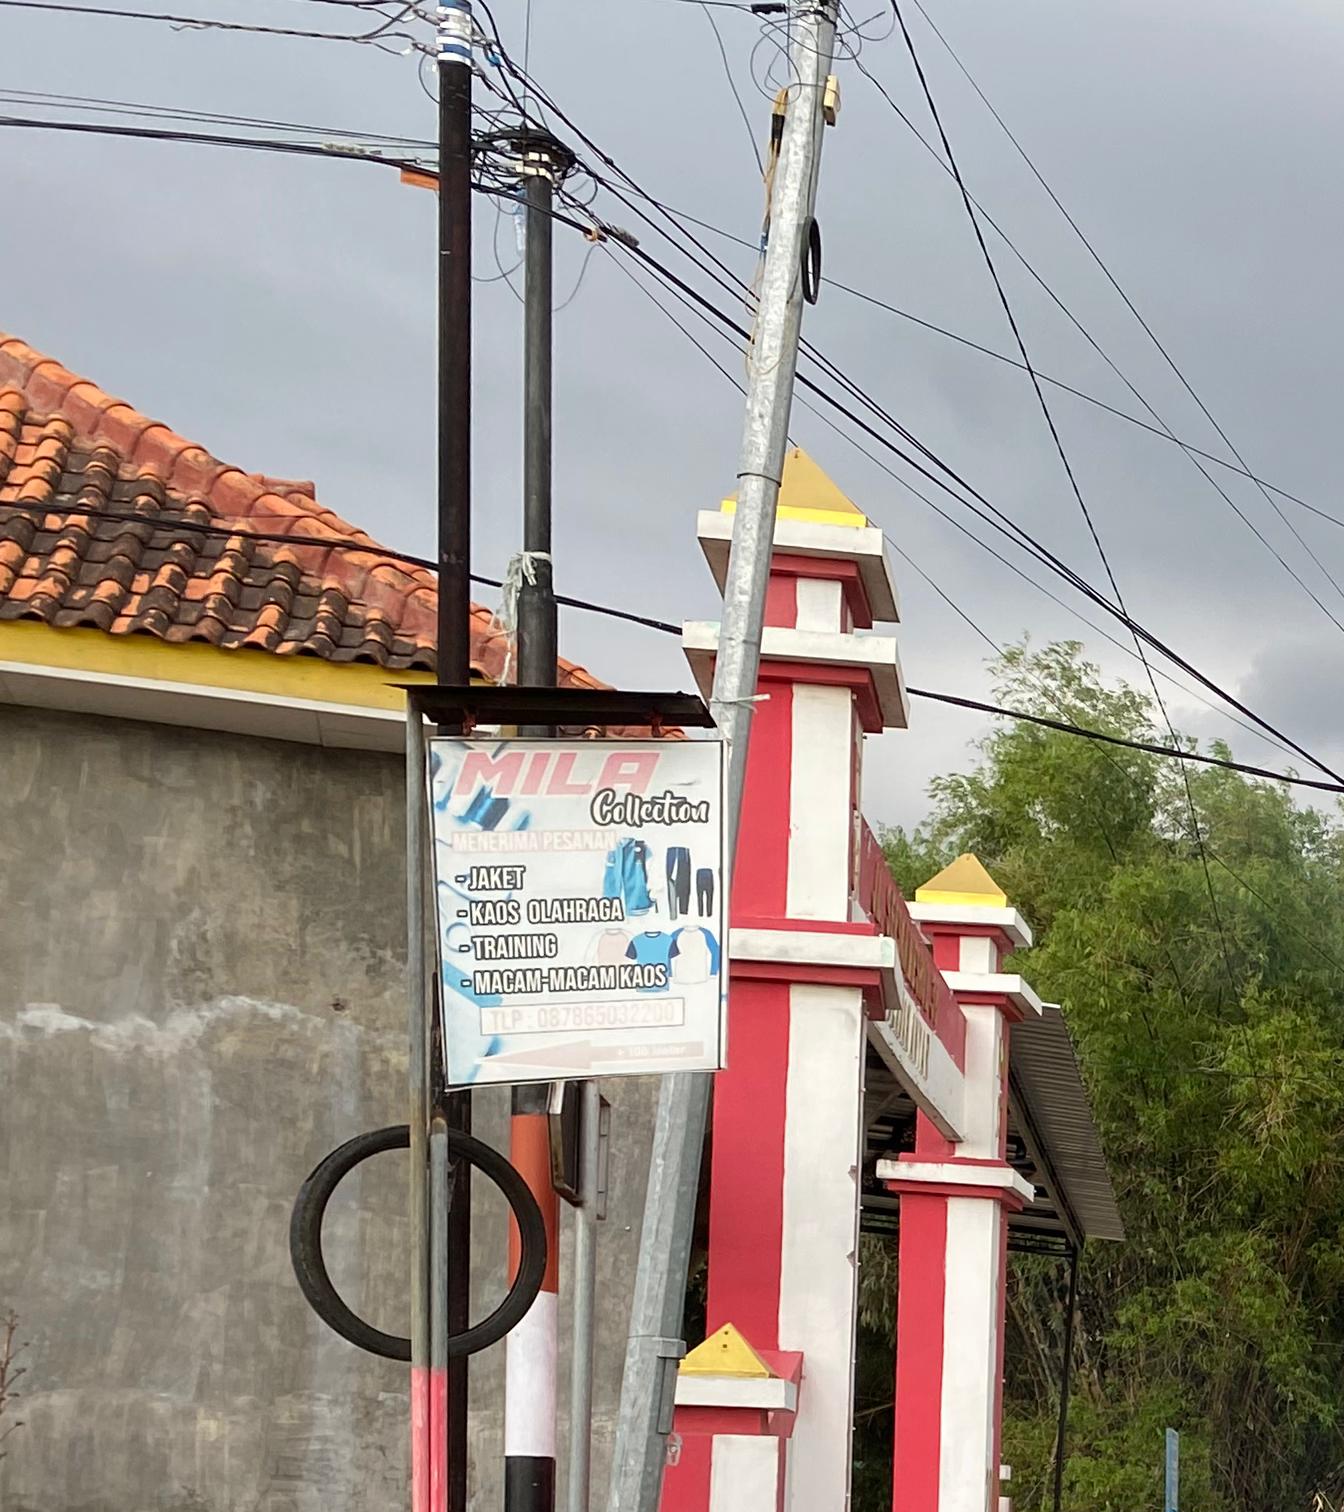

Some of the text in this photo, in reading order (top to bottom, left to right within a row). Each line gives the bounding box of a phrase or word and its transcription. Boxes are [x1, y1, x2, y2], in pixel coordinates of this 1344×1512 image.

[452, 751, 661, 796] MILA
[591, 788, 711, 827] Collection
[453, 831, 616, 850] MENERIMA PESANAN
[467, 864, 526, 891] JAKET
[470, 897, 624, 925] KAOS OLAHRAGA
[472, 934, 558, 960] TRAINING
[474, 963, 668, 995] MACAM-MACAM KAOS
